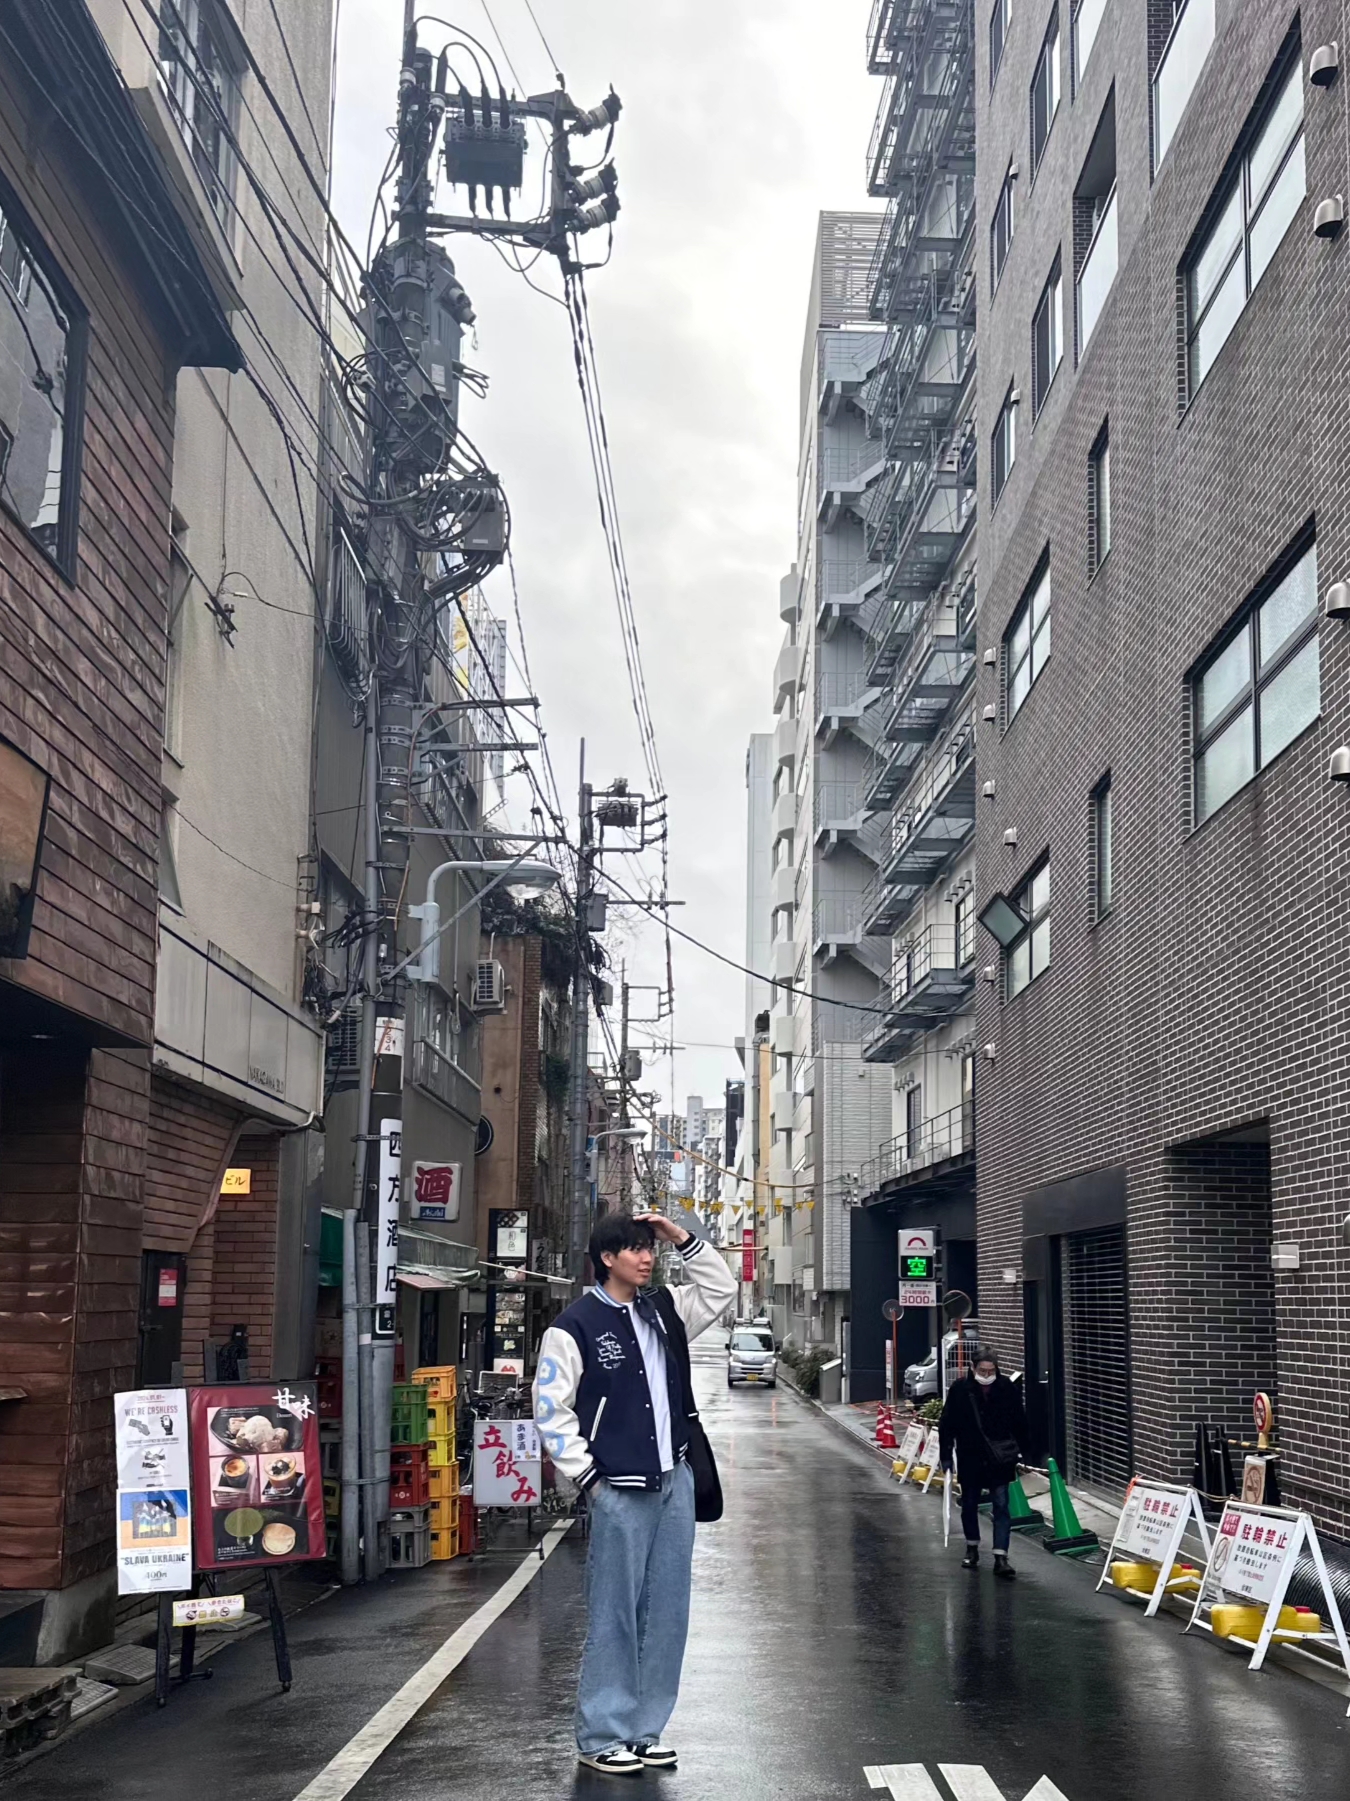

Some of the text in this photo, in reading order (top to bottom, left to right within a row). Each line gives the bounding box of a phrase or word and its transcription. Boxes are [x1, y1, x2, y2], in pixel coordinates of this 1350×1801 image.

[225, 1174, 247, 1186] ビル
[415, 1166, 454, 1206] 酒
[907, 1256, 927, 1277] 空
[147, 1405, 179, 1415] CASHLESS
[271, 1387, 316, 1420] 甘味
[477, 1424, 538, 1503] 立飲み
[1143, 1497, 1179, 1518] 駐輪禁止
[1241, 1523, 1288, 1550] 駐輪禁止
